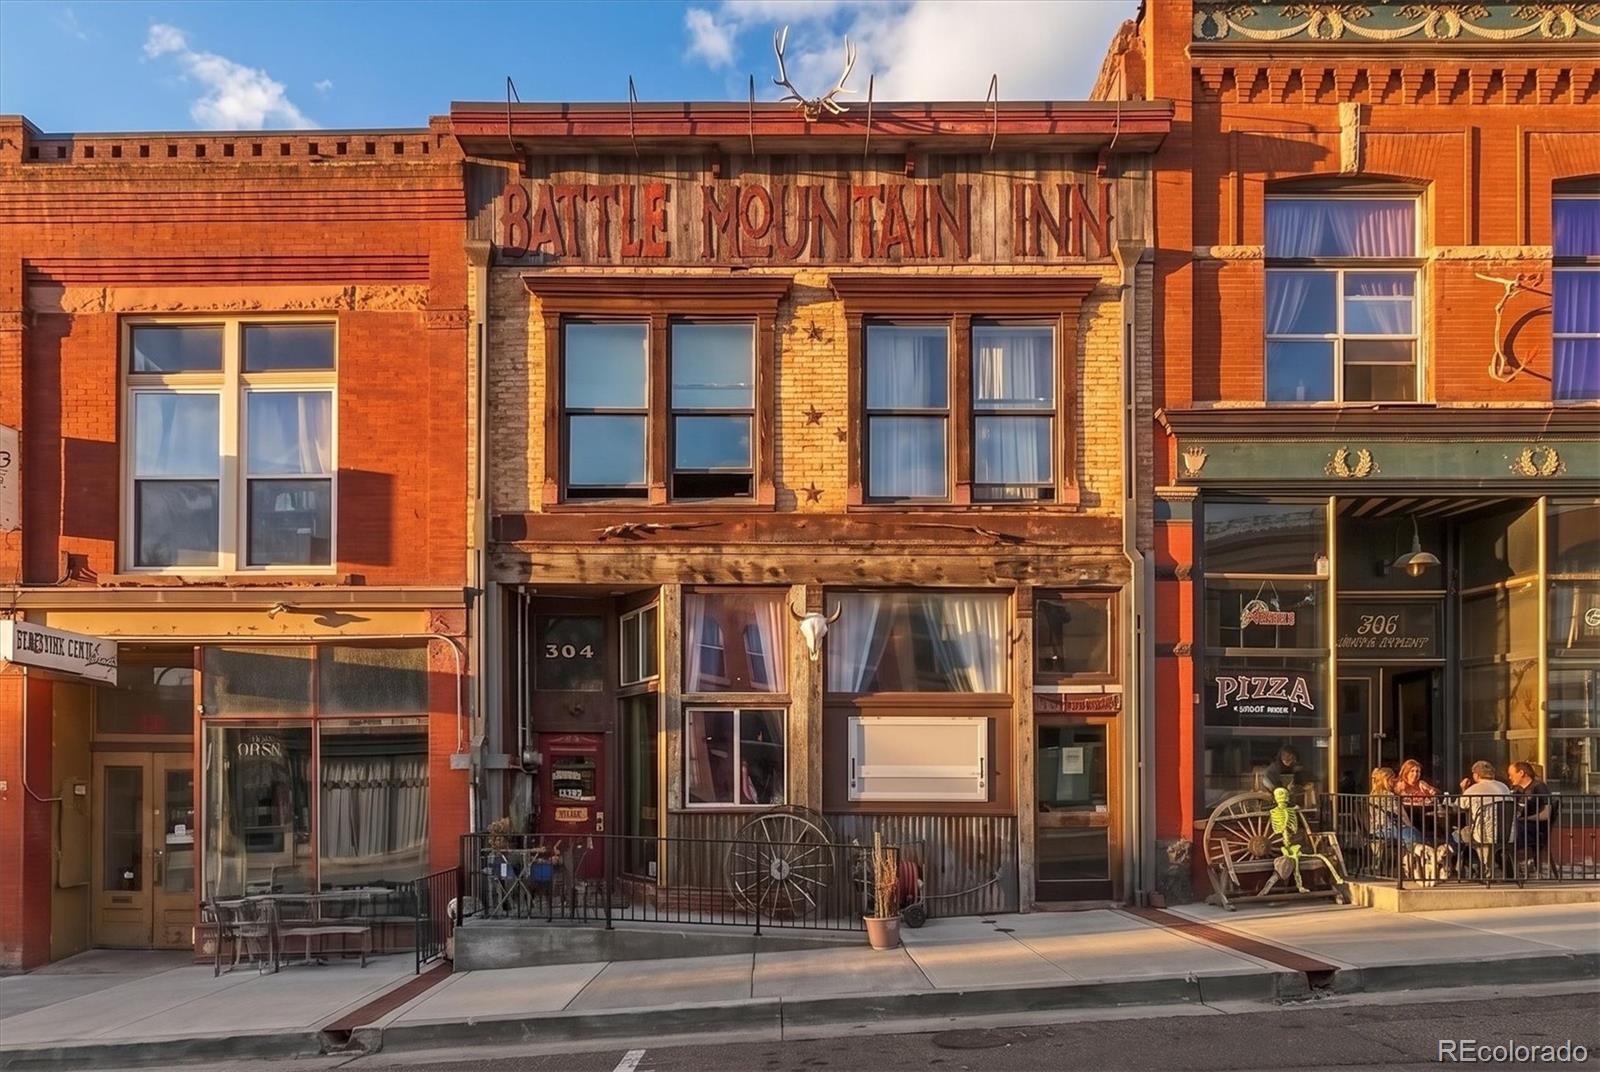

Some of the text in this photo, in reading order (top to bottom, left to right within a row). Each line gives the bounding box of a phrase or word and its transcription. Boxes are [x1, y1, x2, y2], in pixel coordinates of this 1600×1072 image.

[500, 182, 1114, 259] BATTLE MOUNTAIN INN
[1357, 614, 1400, 635] 306
[545, 644, 594, 659] 304
[1215, 675, 1315, 710] PIZZA
